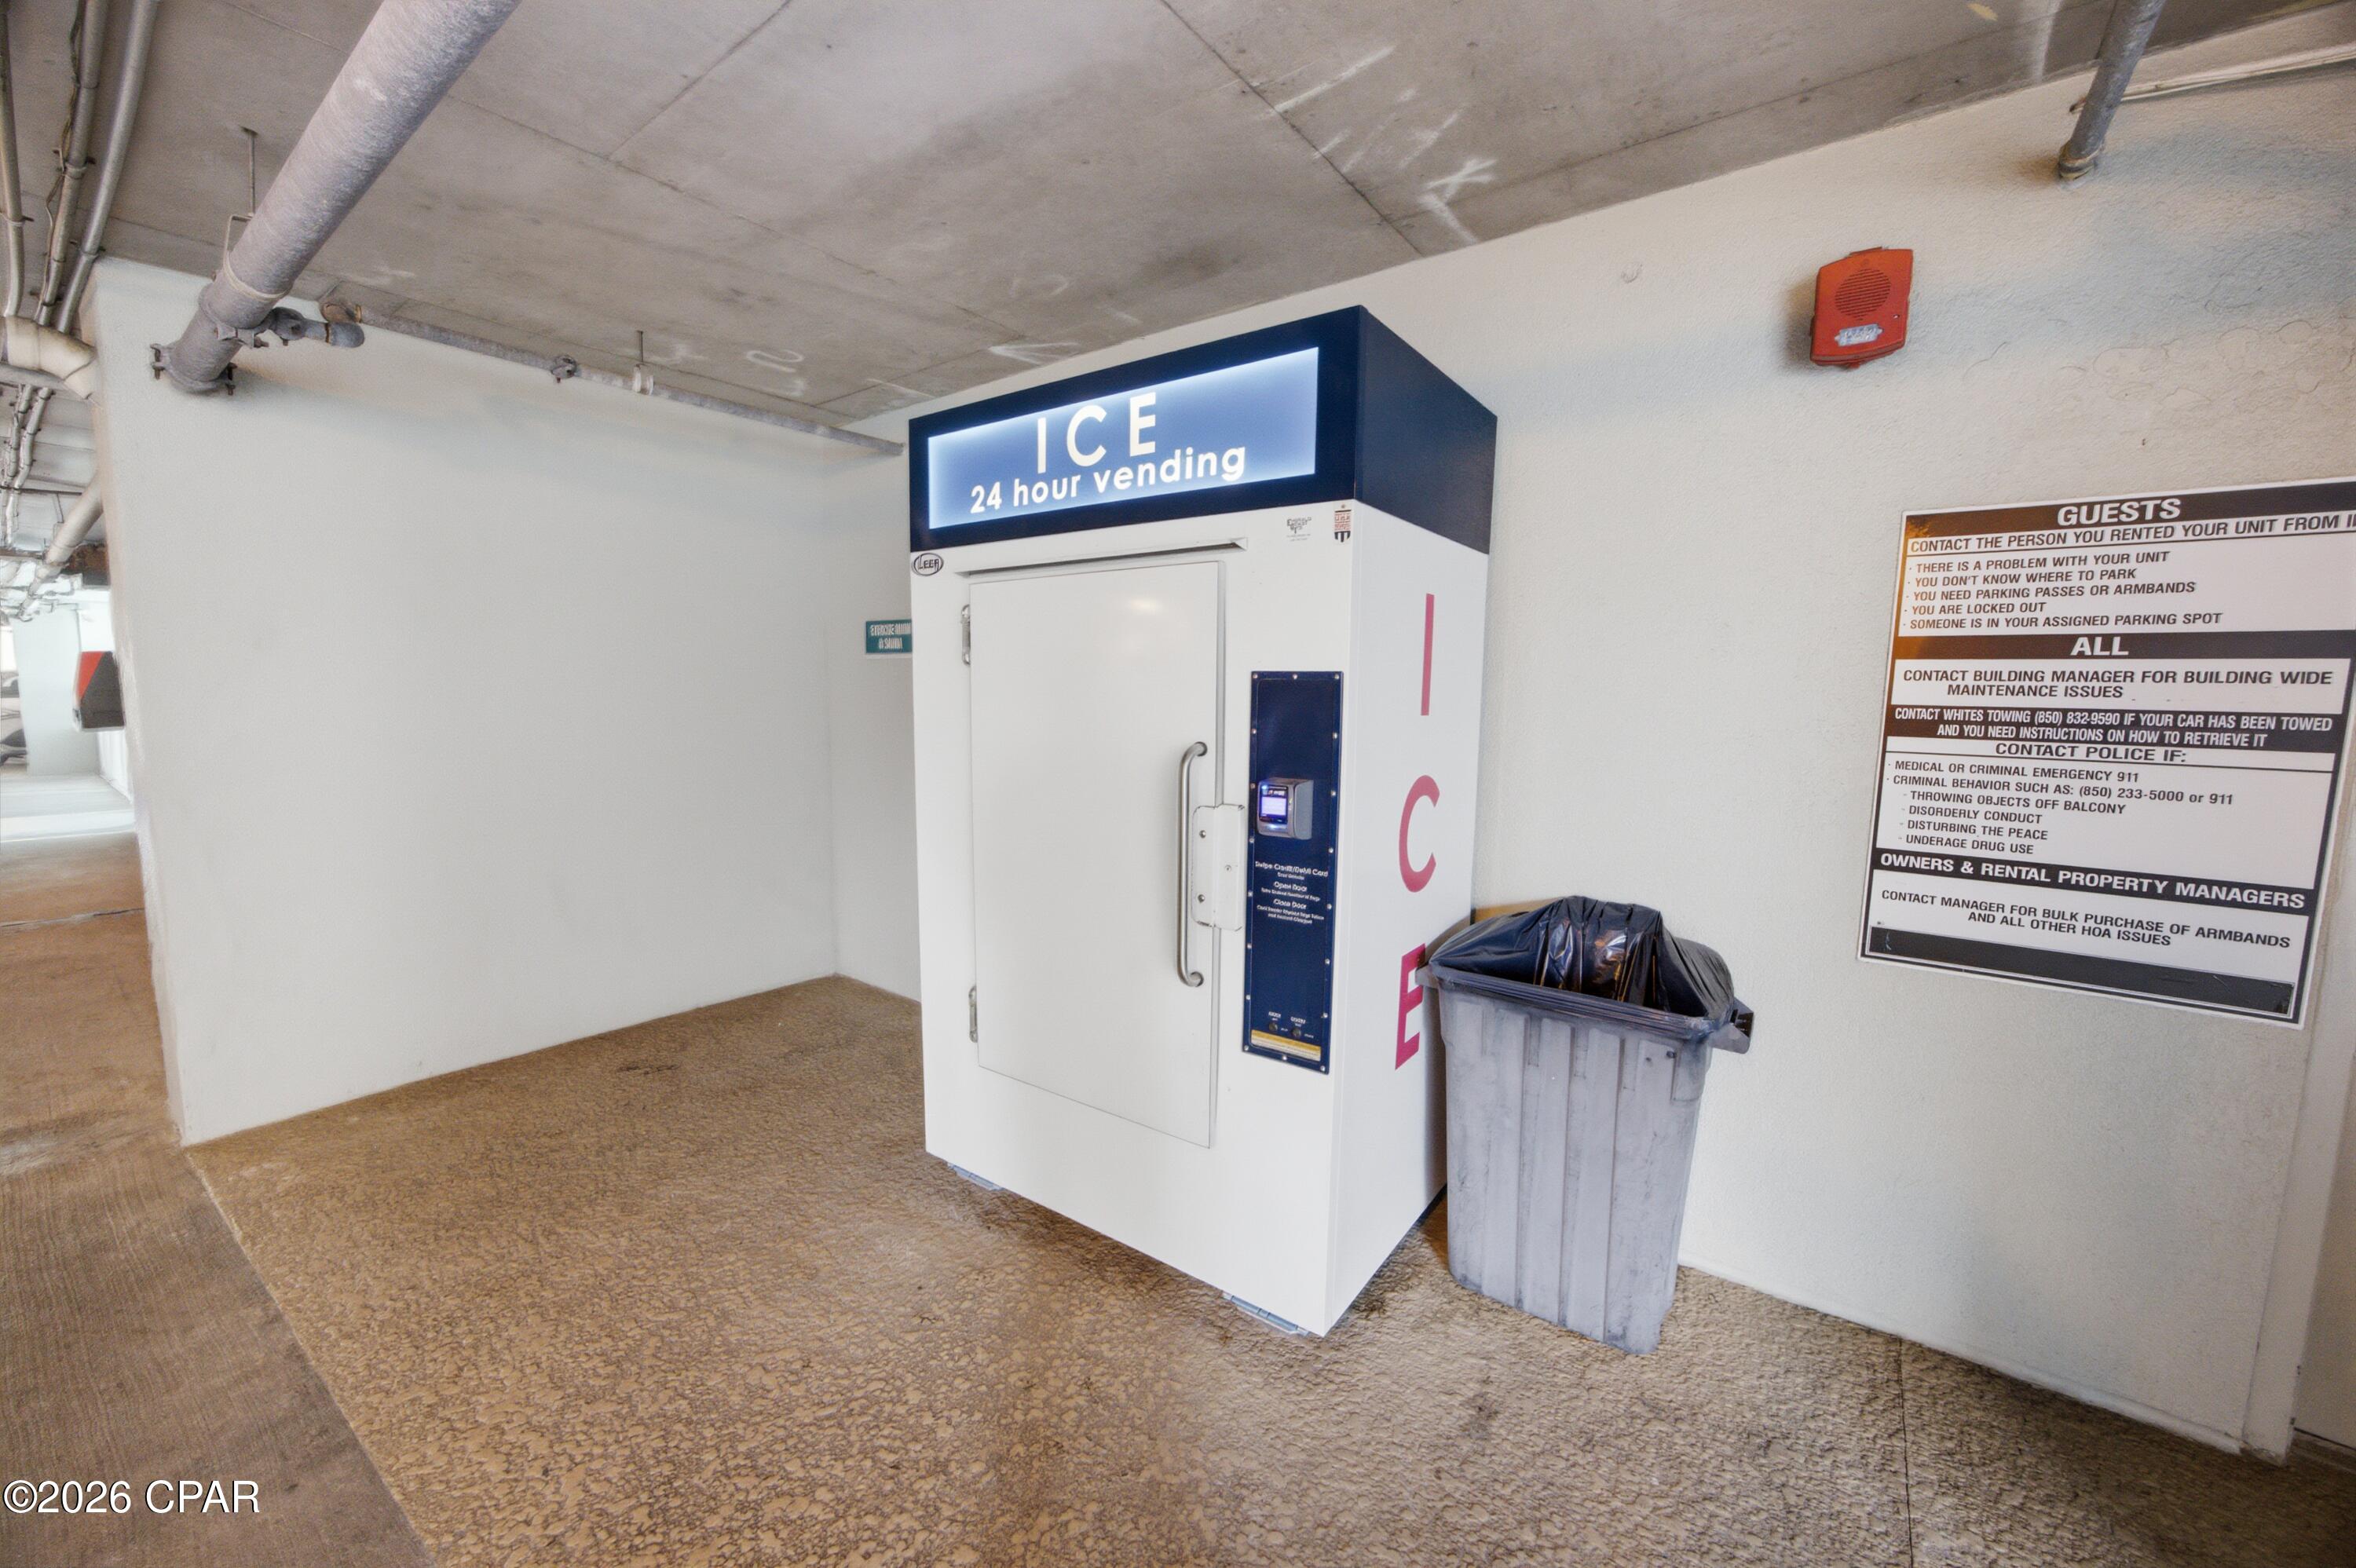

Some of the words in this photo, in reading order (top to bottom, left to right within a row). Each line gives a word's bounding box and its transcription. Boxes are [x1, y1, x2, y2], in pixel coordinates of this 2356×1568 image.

[1037, 392, 1157, 474] ICE
[970, 481, 1002, 514] 24
[1012, 475, 1081, 507] hour
[1095, 447, 1246, 494] vending
[2058, 499, 2181, 527] GUESTS
[1912, 539, 1971, 551] CONTACT
[1976, 536, 2003, 548] THE
[2008, 532, 2067, 546] PERSON
[2074, 530, 2104, 543] YOU
[2111, 526, 2174, 541] RENTED
[2182, 522, 2228, 536] YOUR
[2235, 519, 2277, 534] UNIT
[2284, 515, 2339, 531] FROM
[1917, 562, 1953, 572] THERE
[1958, 561, 1969, 571] IS
[1974, 561, 1981, 570] A
[1987, 557, 2047, 570] PROBLEM
[2053, 556, 2087, 567] WITH
[2094, 554, 2130, 565] YOUR
[2136, 551, 2170, 563] UNIT
[1916, 577, 1938, 587] YOU
[1943, 576, 1978, 586] DON'T
[1983, 574, 2021, 584] KNOW
[2026, 572, 2072, 583] WHERE
[2078, 570, 2094, 580] TO
[2100, 568, 2136, 579] PARK
[1914, 591, 1936, 601] YOU
[1941, 590, 1971, 600] NEED
[1976, 588, 2029, 598] PARKING
[2036, 586, 2084, 597] PASSES
[2091, 585, 2109, 595] OR
[2114, 582, 2196, 594] ARMBANDS
[1913, 605, 1934, 615] YOU
[1939, 605, 1963, 614] ARE
[1967, 603, 2014, 613] LOCKED
[2020, 602, 2047, 612] OUT
[1911, 619, 1966, 629] SOMEONE
[1971, 619, 1982, 628] IS
[1987, 618, 1999, 627] IN
[2005, 617, 2038, 627] YOUR
[2043, 616, 2109, 627] ASSIGNED
[2115, 614, 2177, 625] PARKING
[2183, 613, 2222, 623] SPOT
[2071, 637, 2128, 655] ALL
[1904, 671, 1968, 681] CONTACT
[1974, 671, 2045, 682] BUILDING
[2051, 671, 2135, 682] MANAGER
[2142, 671, 2177, 683] FOR
[2184, 671, 2271, 684] BUILDING
[2281, 672, 2332, 684] WIDE
[1948, 685, 2058, 696] MAINTENANCE
[2064, 686, 2123, 697] ISSUES
[1896, 708, 1941, 719] CONTACT
[1944, 709, 1983, 721] WHITES
[1987, 710, 2031, 722] TOWING
[2067, 712, 2120, 725] 832-9590
[2124, 713, 2135, 725] IF
[2139, 714, 2173, 726] YOUR
[2178, 715, 2204, 727] CAR
[2208, 715, 2236, 728] HAS
[2241, 716, 2276, 729] BEEN
[2281, 717, 2332, 731] TOWED
[1937, 725, 1959, 736] AND
[1963, 726, 1985, 736] YOU
[1988, 726, 2016, 738] NEED
[2020, 727, 2103, 741] INSTRUCTIONS
[2108, 729, 2125, 741] ON
[2129, 730, 2160, 743] HOW
[2164, 731, 2180, 744] TO
[2184, 732, 2249, 746] RETRIEVE
[2253, 734, 2267, 747] IT
[1996, 744, 2079, 757] CONTACT
[2086, 747, 2155, 760] POLICE
[2164, 750, 2186, 762] IF:
[1896, 761, 1944, 772] MEDICAL
[1949, 763, 1965, 773] OR
[1970, 765, 2027, 776] CRIMINAL
[2033, 768, 2113, 780] EMERGENCY
[2117, 772, 2138, 782] 911
[1894, 776, 1947, 787] CRIMINAL
[1952, 779, 2010, 791] BEHAVIOR
[2015, 782, 2048, 793] SUCH
[2054, 784, 2073, 795] AS:
[2080, 786, 2111, 799] (850)
[2117, 788, 2183, 802] 233-5000
[2210, 794, 2232, 804] 911
[1911, 791, 1972, 803] THROWING
[1977, 795, 2030, 807] OBJECTS
[2036, 799, 2059, 809] OFF
[2064, 801, 2125, 813] BALCONY
[1909, 806, 1979, 819] DISORDERLY
[1985, 811, 2042, 824] CONDUCT
[1908, 820, 1976, 834] DISTURBING
[1981, 826, 2003, 836] THE
[2009, 828, 2048, 839] PEACE
[1907, 835, 1966, 848] UNDERAGE
[1972, 840, 2004, 851] DRUG
[2010, 843, 2033, 854] USE
[1881, 853, 1954, 872] OWNERS
[1961, 861, 1973, 873] &
[1981, 863, 2051, 881] RENTAL
[2058, 871, 2168, 894] PROPERTY
[2175, 883, 2304, 908] MANAGERS
[1882, 890, 1937, 905] CONTACT
[1941, 897, 2004, 913] MANAGER
[2010, 905, 2037, 916] FOR
[2043, 909, 2078, 922] BULK
[2084, 914, 2164, 932] PURCHASE
[2170, 924, 2190, 934] OF
[2195, 927, 2290, 948] ARMBANDS
[1968, 912, 1995, 923] AND
[2000, 916, 2025, 927] ALL
[2031, 919, 2076, 934] OTHER
[2082, 926, 2111, 938] HOA
[2117, 930, 2171, 945] ISSUES
